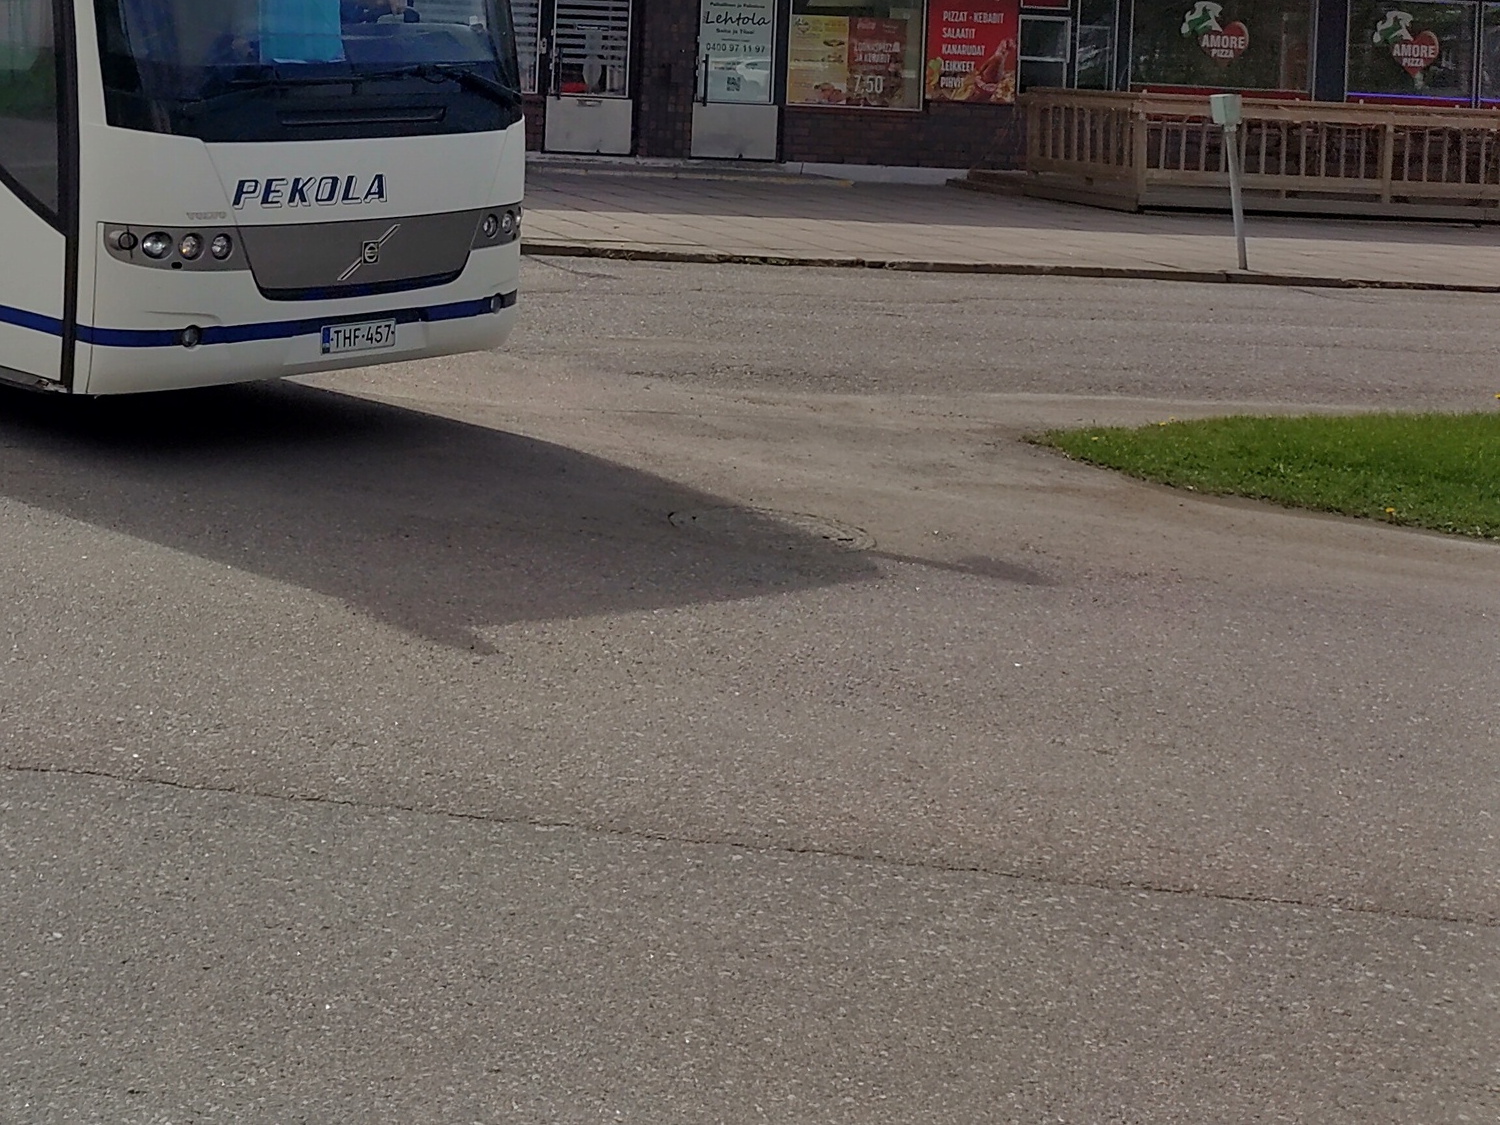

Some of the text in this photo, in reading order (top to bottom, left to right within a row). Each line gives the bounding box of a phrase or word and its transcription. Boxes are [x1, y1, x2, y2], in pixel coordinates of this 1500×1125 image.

[705, 11, 771, 26] Lehtola
[943, 10, 968, 23] PIZZAT
[973, 12, 1005, 24] KEBABIT
[942, 27, 976, 40] SALAATIT
[706, 42, 766, 53] 0400 97 11 97
[1201, 33, 1246, 50] AMORE
[1210, 48, 1235, 59] PIZZA
[1392, 43, 1436, 58] AMORE
[940, 60, 975, 72] LEIKKEET
[1401, 57, 1425, 68] PIZZA
[231, 173, 388, 210] PEKOLA
[333, 323, 392, 349] THF-457
